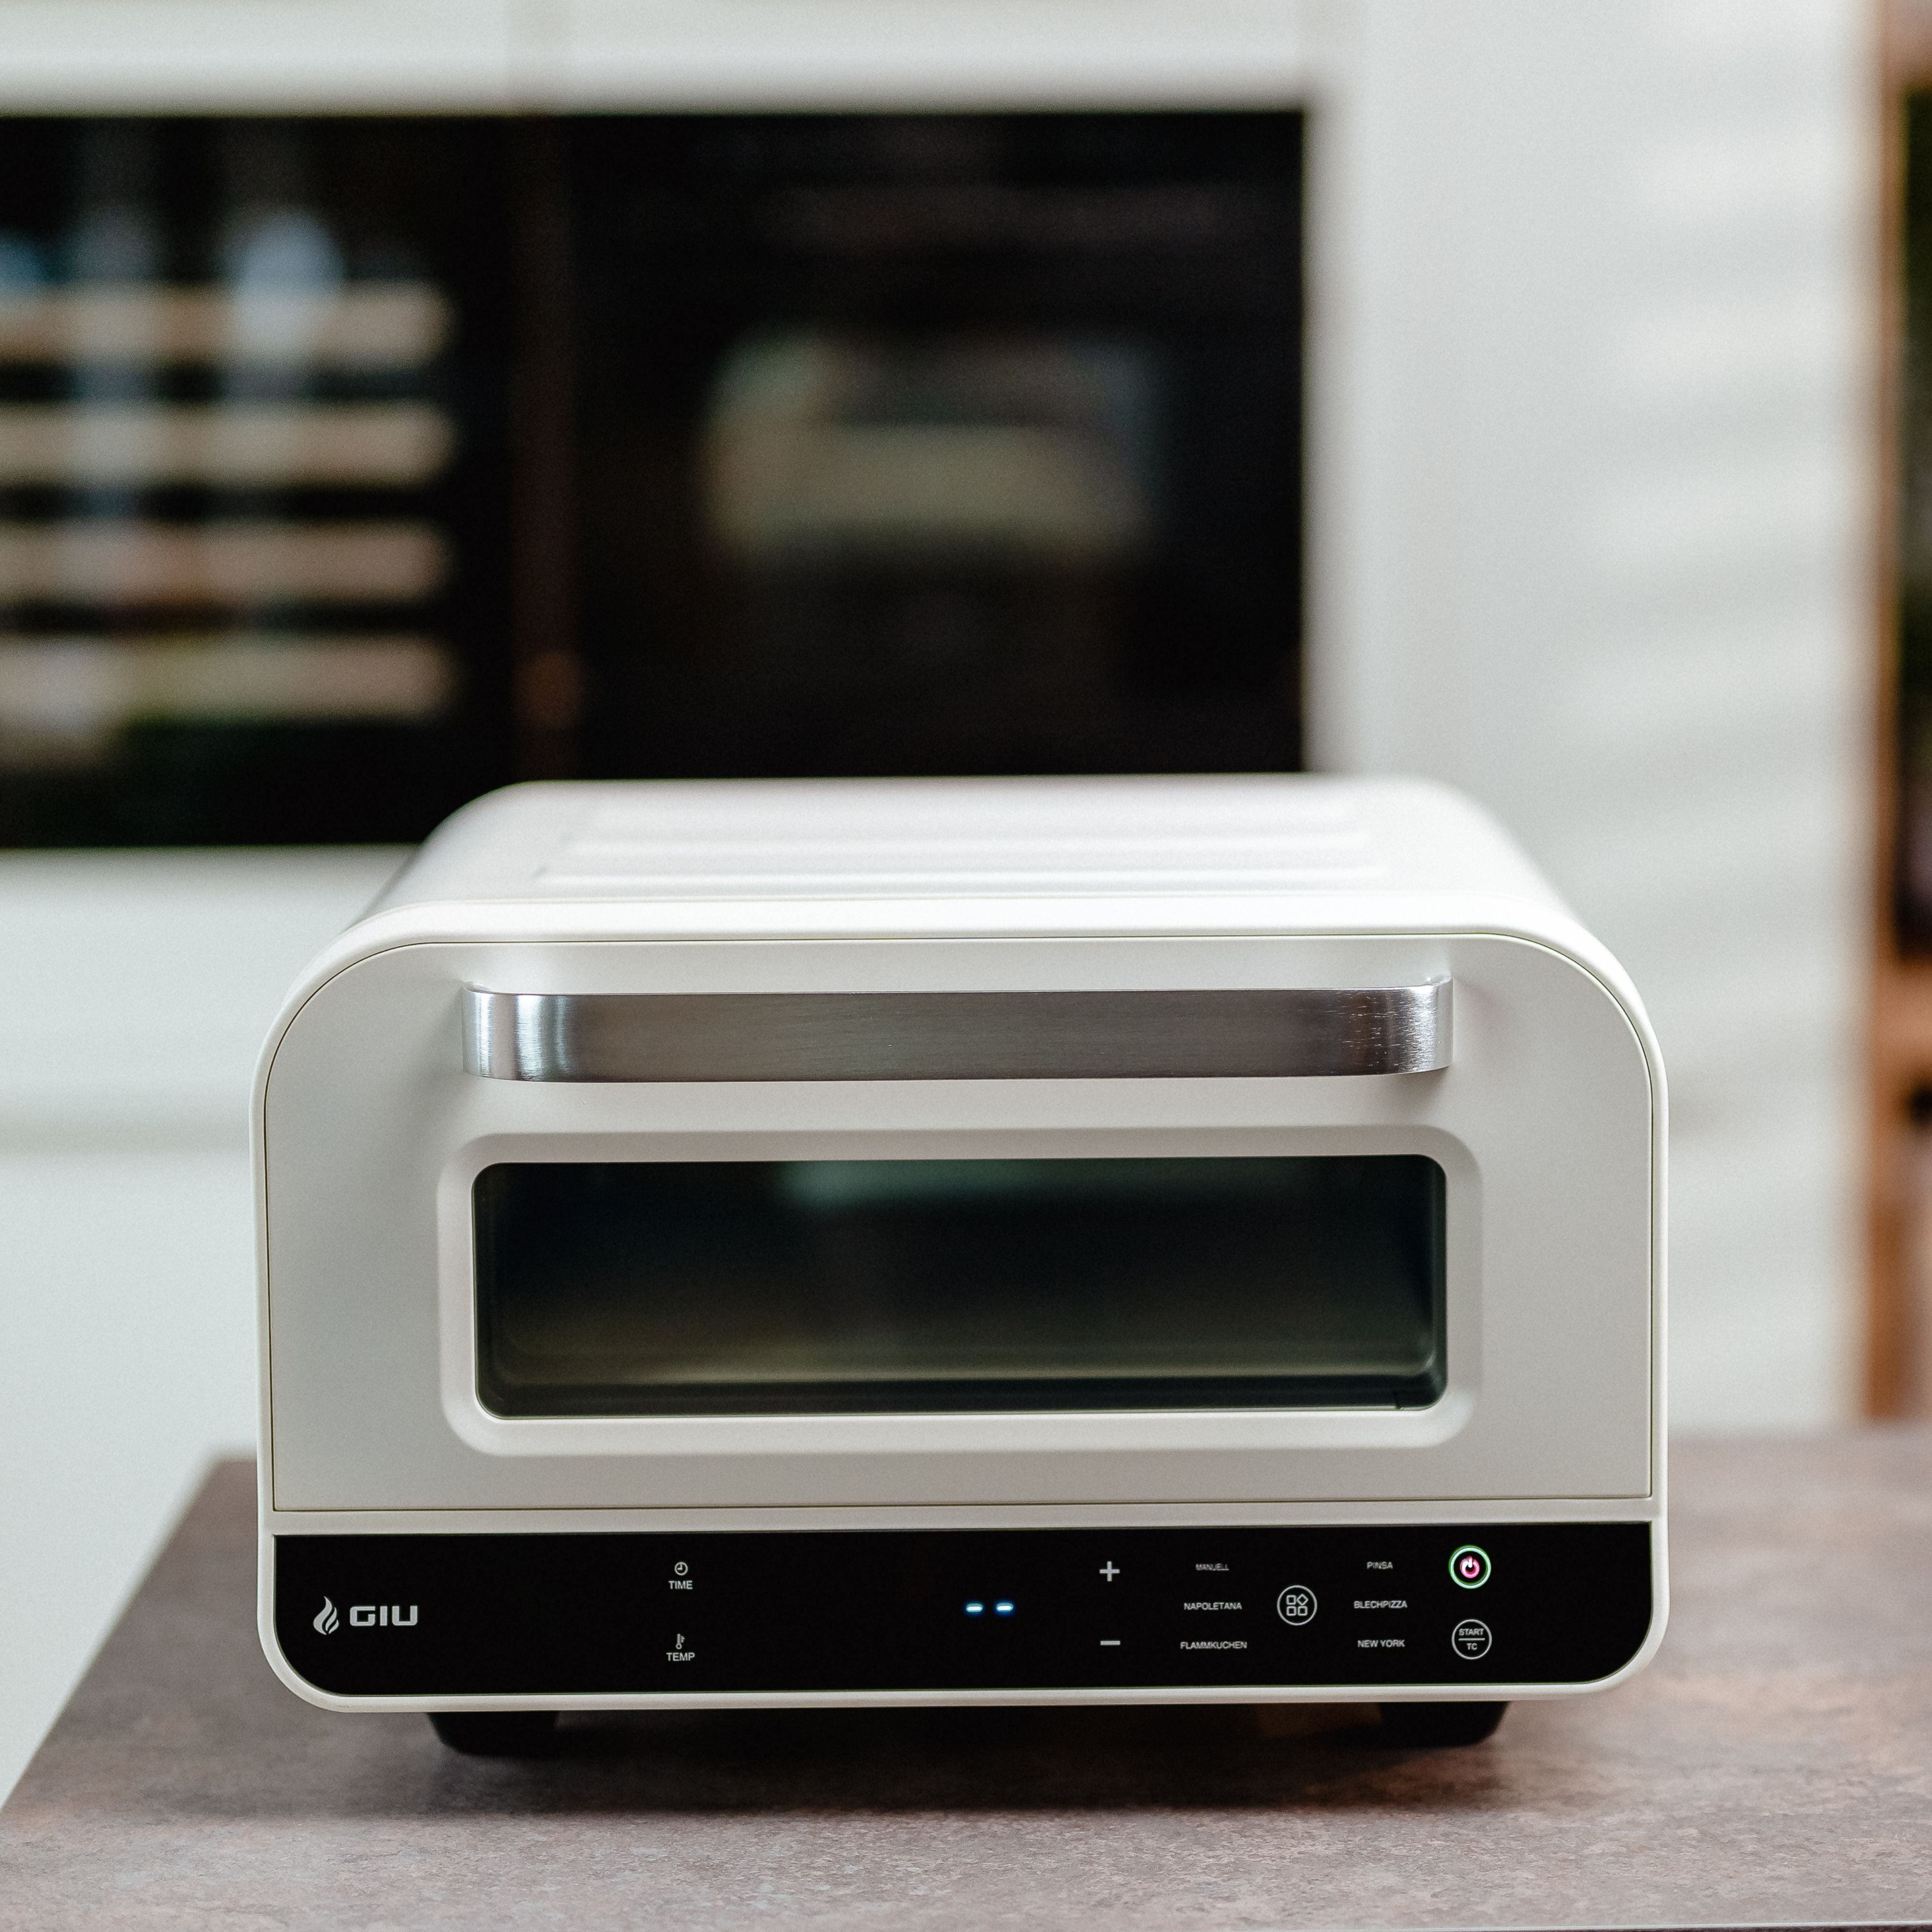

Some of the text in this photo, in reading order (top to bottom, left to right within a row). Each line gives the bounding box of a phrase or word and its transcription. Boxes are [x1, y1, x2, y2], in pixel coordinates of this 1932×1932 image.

[668, 1580, 693, 1590] TIME
[1184, 1602, 1242, 1610] NAPOLETANA
[1354, 1600, 1407, 1609] BLECHPIZZA
[350, 1605, 418, 1627] GIU
[1180, 1641, 1248, 1649] FLAMMKUCHEN
[1357, 1639, 1405, 1648] NEW YORK
[666, 1652, 696, 1662] TEMP
